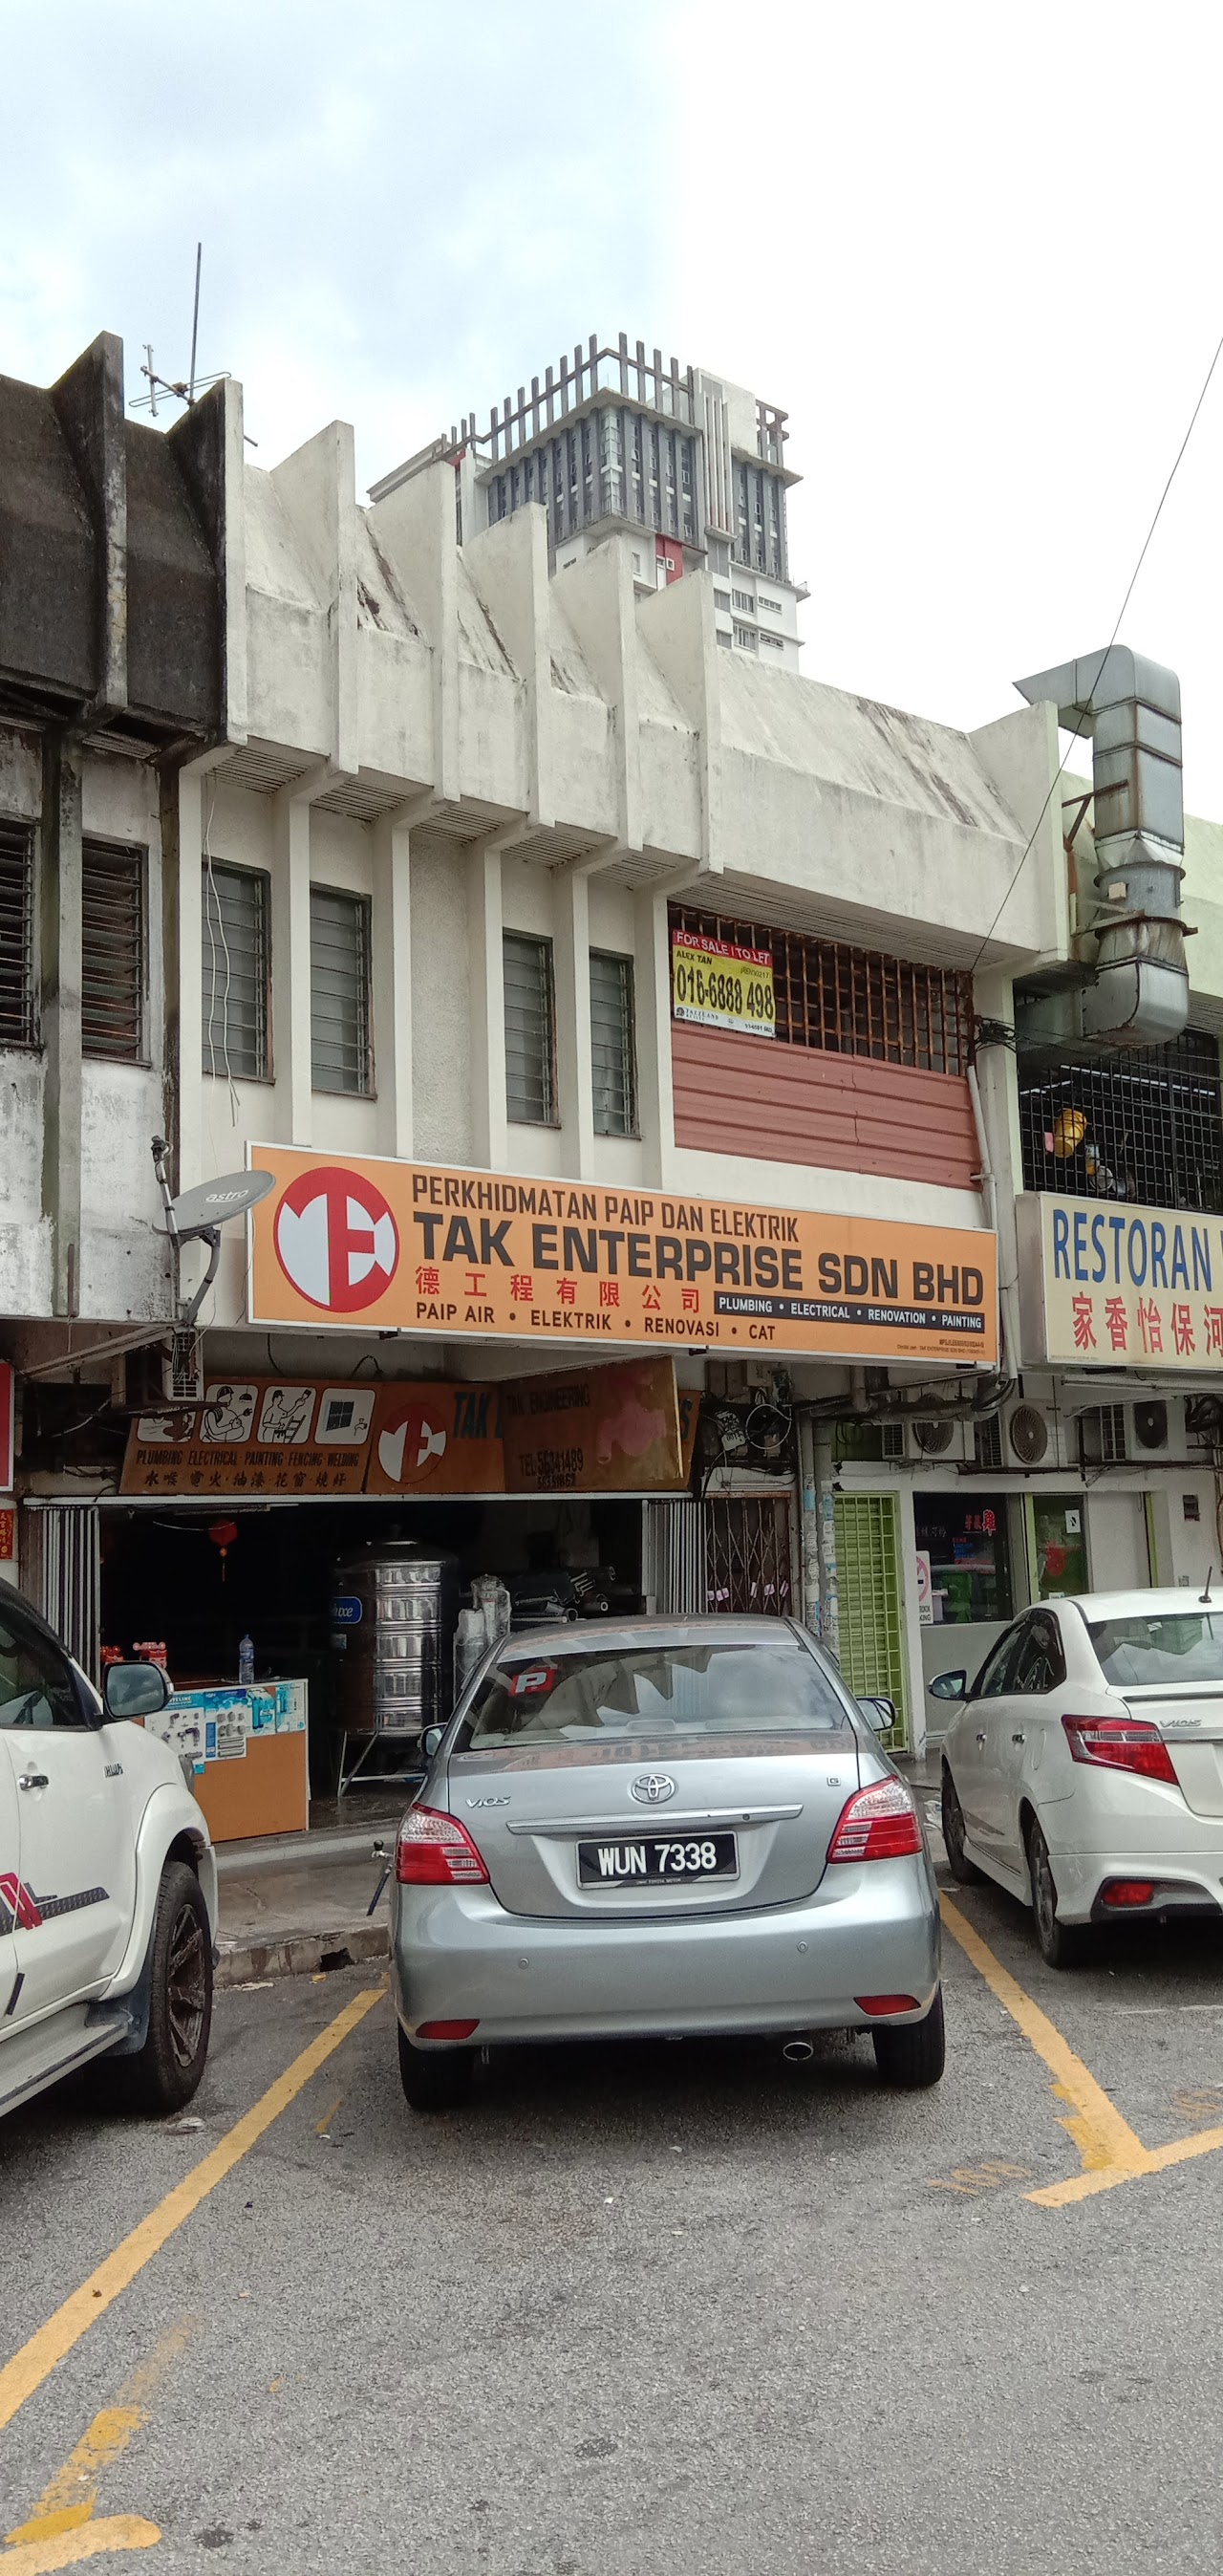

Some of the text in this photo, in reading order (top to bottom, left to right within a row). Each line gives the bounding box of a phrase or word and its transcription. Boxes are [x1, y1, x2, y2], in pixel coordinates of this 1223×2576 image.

[676, 931, 699, 947] FOR
[701, 939, 729, 956] SALE
[735, 947, 751, 960] TO
[753, 952, 769, 964] LET
[676, 950, 713, 965] ALEX TAN
[676, 963, 774, 1020] 016-6888 498
[205, 1189, 248, 1202] astro
[412, 1174, 799, 1243] PERKHIDMATAN PAIP DAN ELEKTRIK
[413, 1211, 984, 1306] TAK ENTERPRISE SDN BHD
[1053, 1209, 1212, 1292] RESTORAN
[415, 1266, 699, 1313] 德工程有限公司
[416, 1302, 776, 1340] PAIP AIR ELEKTRIK RENOVASI CAT
[719, 1296, 982, 1330] PLUMBING ELECTRICAL RENOVATION PAINTING
[1072, 1291, 1223, 1357] 家香怡保河
[452, 1392, 492, 1439] TAK
[136, 1449, 360, 1466] PLUMBING ELECTRICAL PAINTING FENCING WELDING
[515, 1672, 547, 1693] P
[465, 1796, 512, 1808] VIOS
[597, 1841, 717, 1876] WUN 7338
